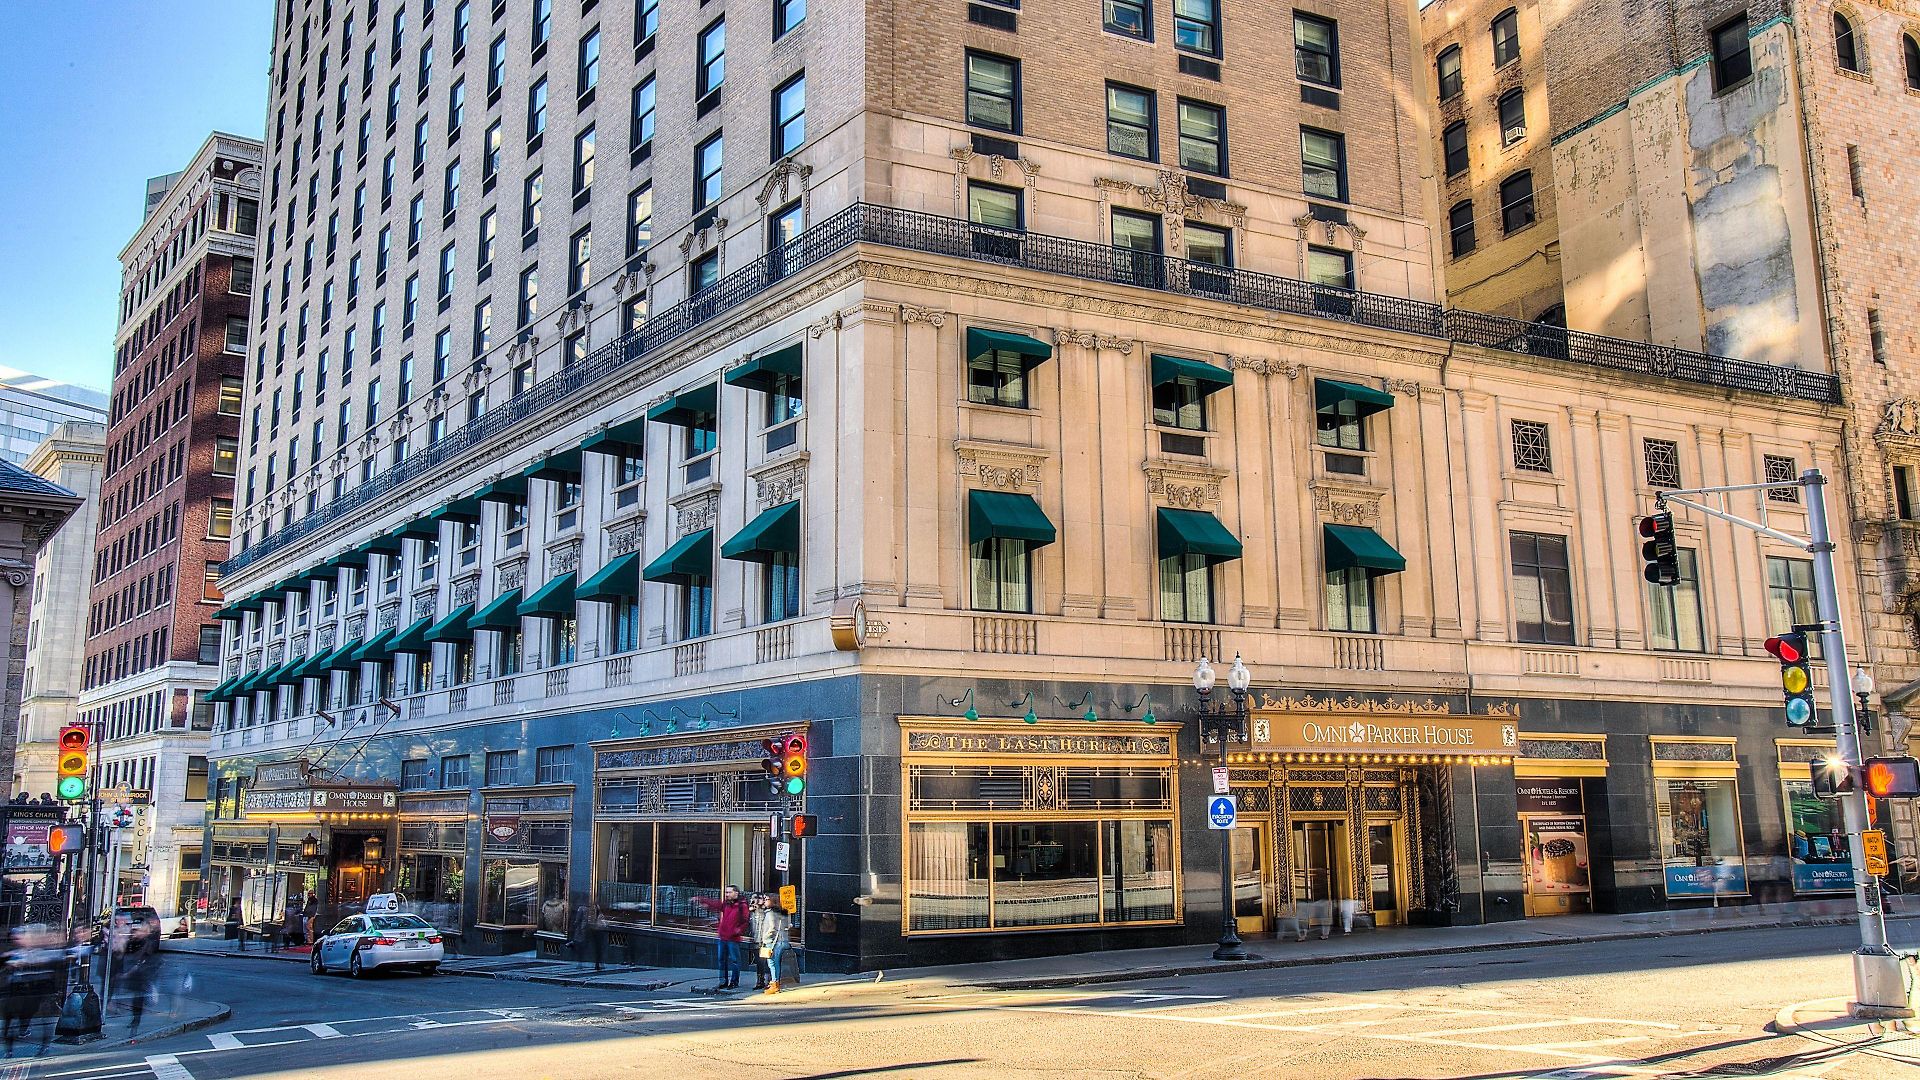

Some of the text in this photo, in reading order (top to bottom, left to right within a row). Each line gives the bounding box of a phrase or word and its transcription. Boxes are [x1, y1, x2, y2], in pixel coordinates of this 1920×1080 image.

[1302, 722, 1475, 745] OMNI PARKER HOUSE
[945, 736, 1137, 752] THE LAST HURRAH
[328, 791, 382, 800] OMNI PARKER
[1517, 787, 1531, 795] OMNI
[1536, 787, 1553, 795] HOTELS
[1559, 787, 1579, 795] RESORTS
[343, 799, 368, 807] HOUSE
